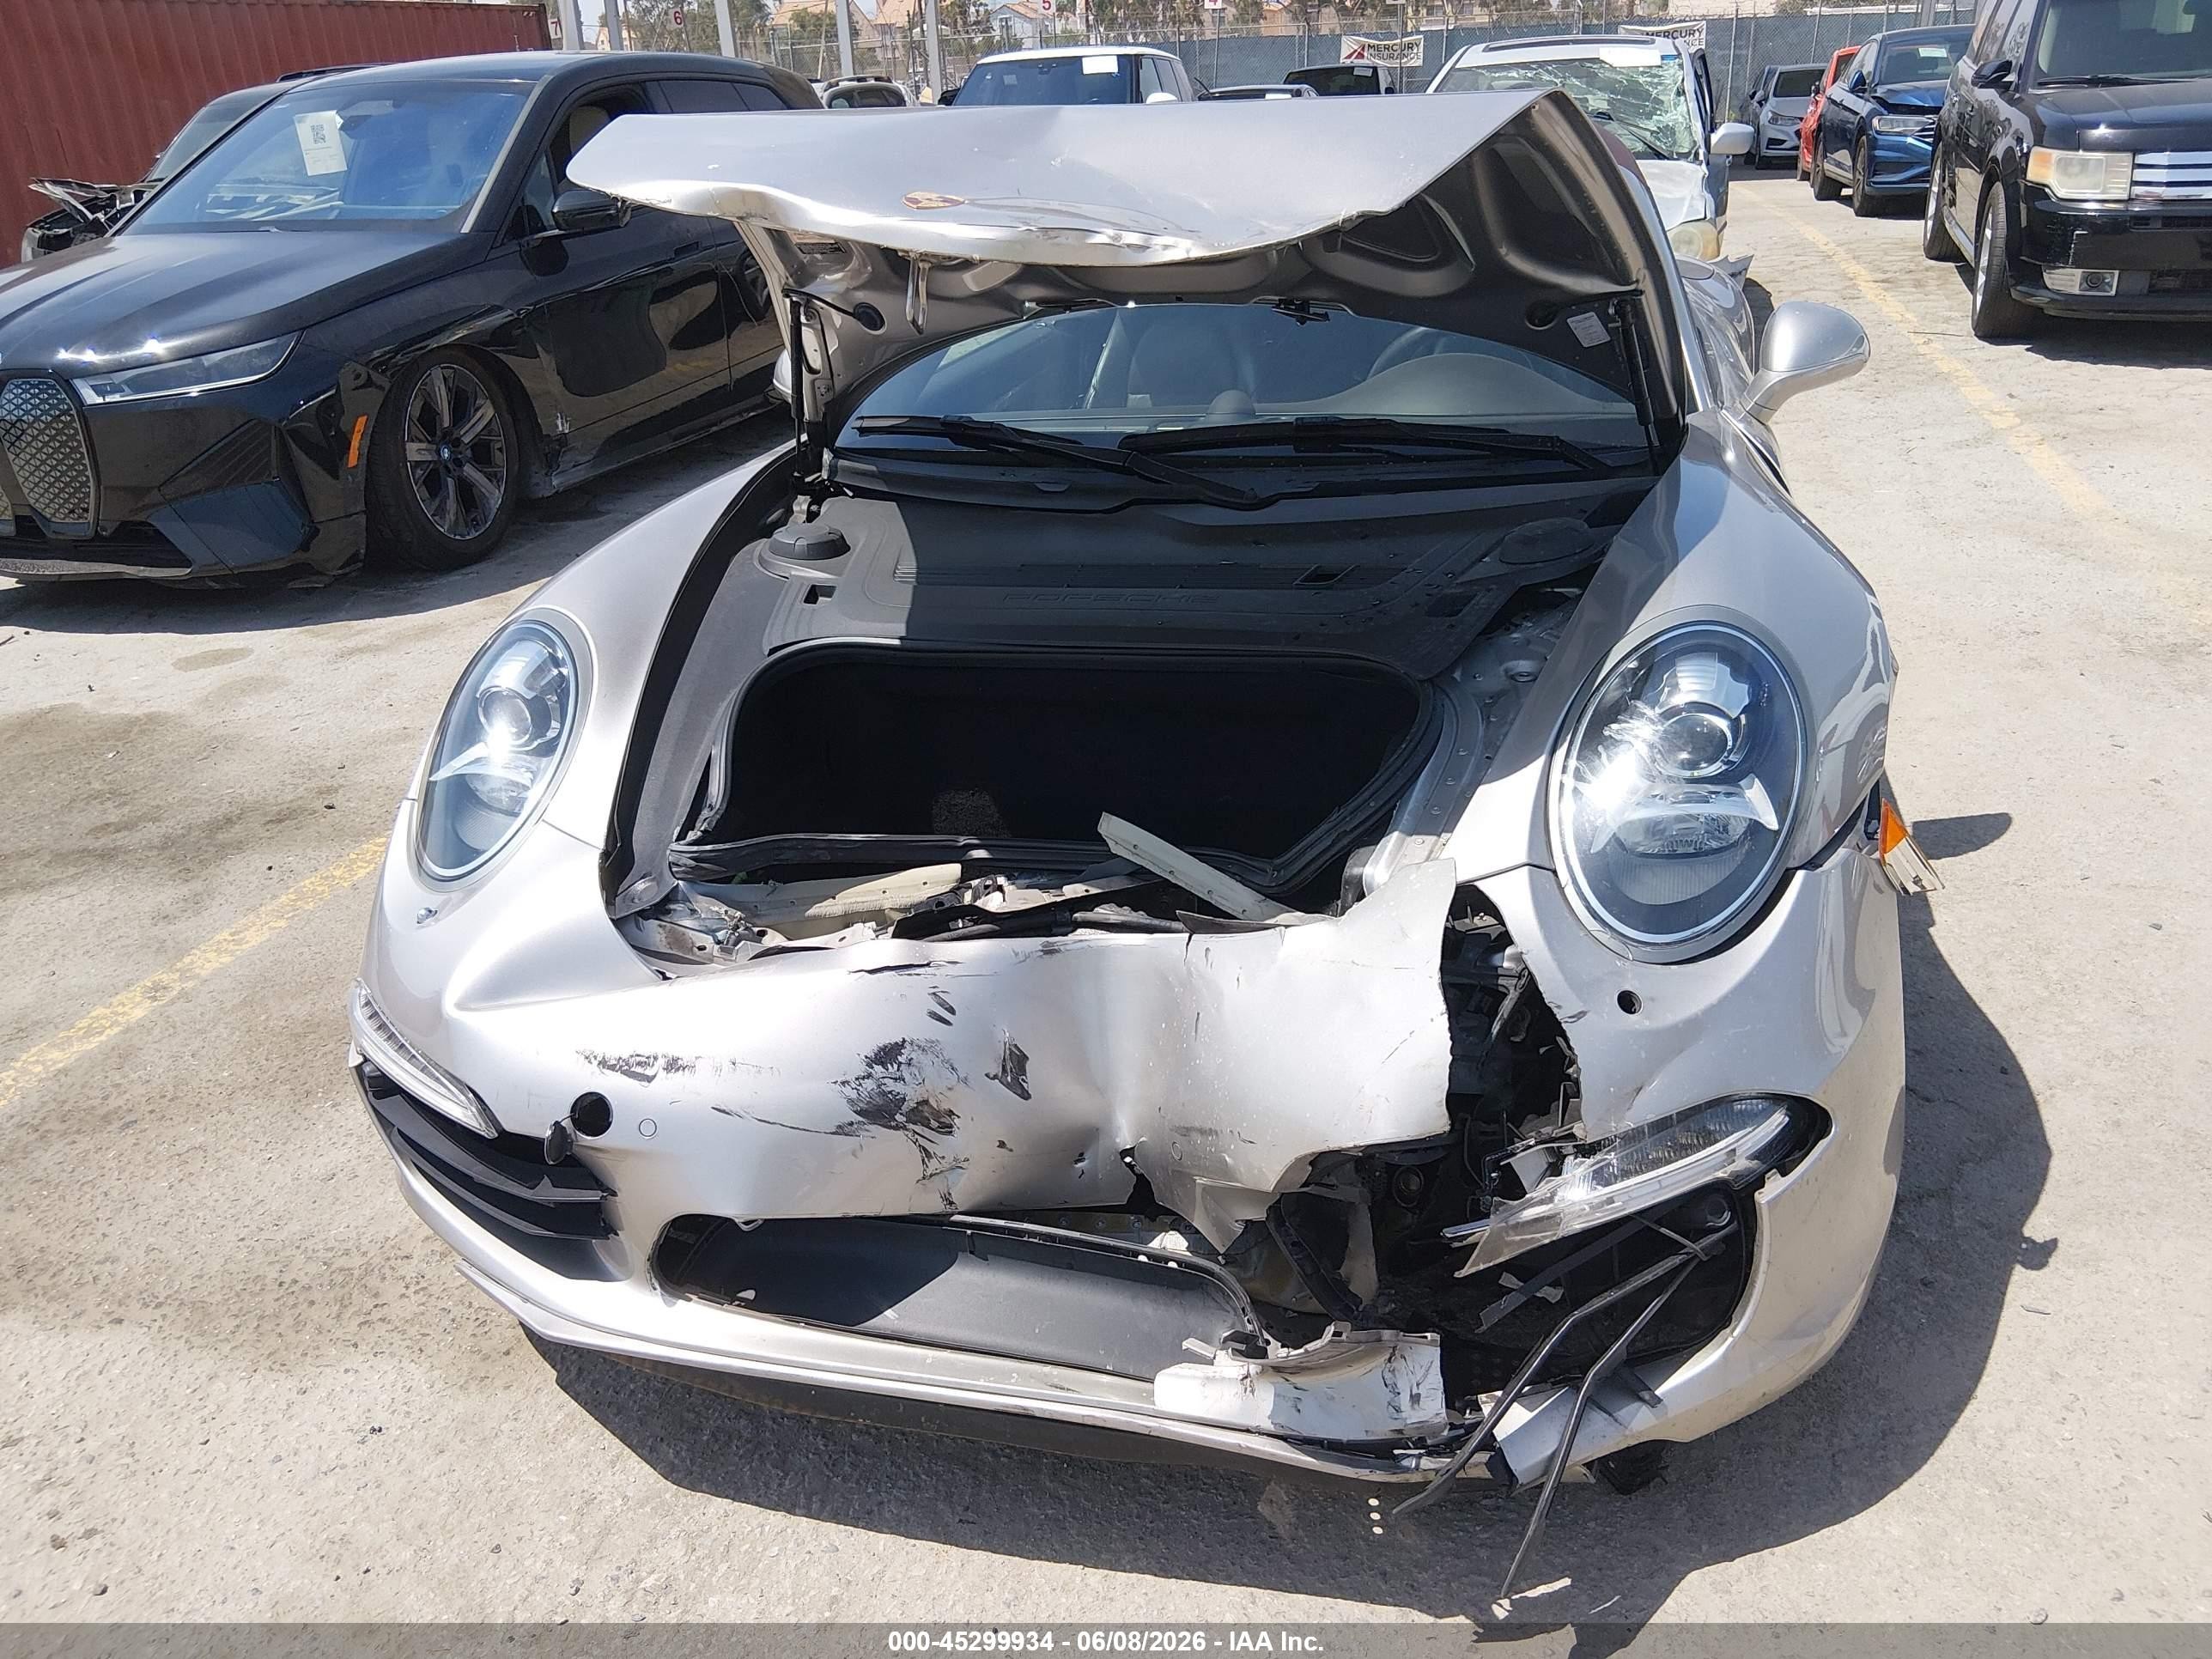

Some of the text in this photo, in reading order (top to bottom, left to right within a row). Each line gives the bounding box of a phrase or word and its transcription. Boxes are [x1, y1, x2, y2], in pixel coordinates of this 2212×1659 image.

[1042, 0, 1052, 10] 5
[674, 10, 683, 26] 6
[550, 21, 558, 36] 7
[1367, 41, 1422, 52] MERCURY
[1366, 52, 1422, 61] INSURANCE
[1003, 592, 1219, 604] PORSCHE
